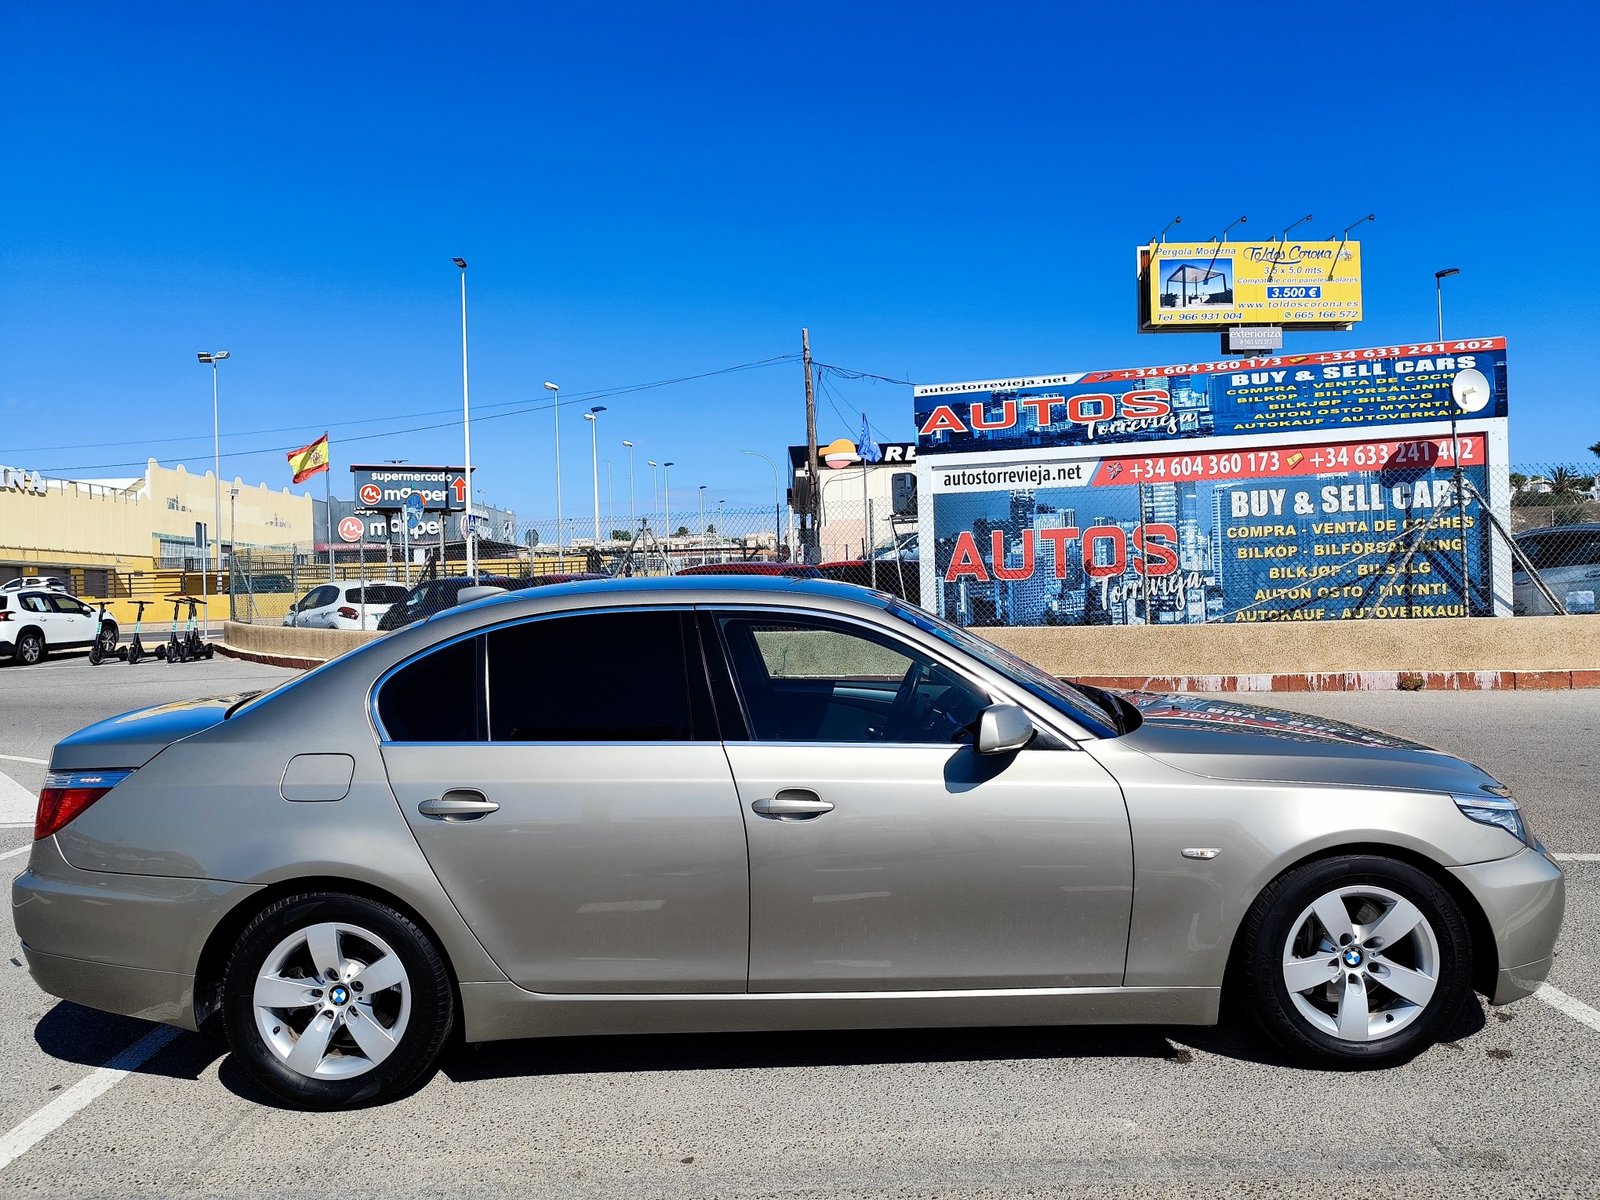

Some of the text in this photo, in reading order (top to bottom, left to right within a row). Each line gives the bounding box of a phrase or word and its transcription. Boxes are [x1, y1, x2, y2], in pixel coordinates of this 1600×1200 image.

[1195, 247, 1236, 256] Moderna
[1289, 245, 1332, 260] Corona
[1288, 266, 1303, 276] 5,0
[1271, 288, 1317, 298] 3.500 €
[1238, 301, 1359, 309] www.toldoscorona.es
[1294, 310, 1358, 319] 665 166 572
[1157, 313, 1175, 321] Tel.
[1178, 313, 1198, 321] 966
[1222, 312, 1243, 320] 004
[1229, 329, 1282, 338] exterioriza
[1317, 339, 1494, 362] +34 633 241 402
[1120, 357, 1282, 378] +34 604 360 173
[1231, 355, 1476, 387] BUY & SELL CARS
[920, 376, 1068, 394] autostorrevieja.net
[1226, 384, 1296, 396] COMPRA
[1313, 379, 1370, 390] VENTA
[1376, 376, 1398, 385] DE
[1237, 392, 1298, 404] BILKÖP
[1269, 399, 1341, 411] BILKJØP
[1358, 391, 1433, 405] BILSALG
[919, 389, 1171, 435] AUTOS
[1254, 409, 1312, 420] AUTON
[1317, 405, 1363, 416] OSTO
[1380, 400, 1450, 412] MYYNTI
[1083, 411, 1198, 440] Torrevieja
[1233, 418, 1325, 431] AUTOKAUF
[1309, 438, 1473, 468] +34 633 241 402
[1129, 451, 1280, 479] +34 604 360 173
[371, 472, 452, 482] supermercado
[943, 464, 1082, 486] autostorrevieja.net
[1231, 488, 1287, 518] BUY
[1293, 491, 1314, 515] &
[1321, 483, 1384, 512] SELL
[1226, 525, 1297, 539] COMPRA
[1312, 520, 1369, 535] VENTA
[1374, 519, 1397, 532] DE
[944, 522, 1179, 583] AUTOS
[1237, 544, 1298, 560] BILKÖP
[1254, 586, 1312, 601] AUTON
